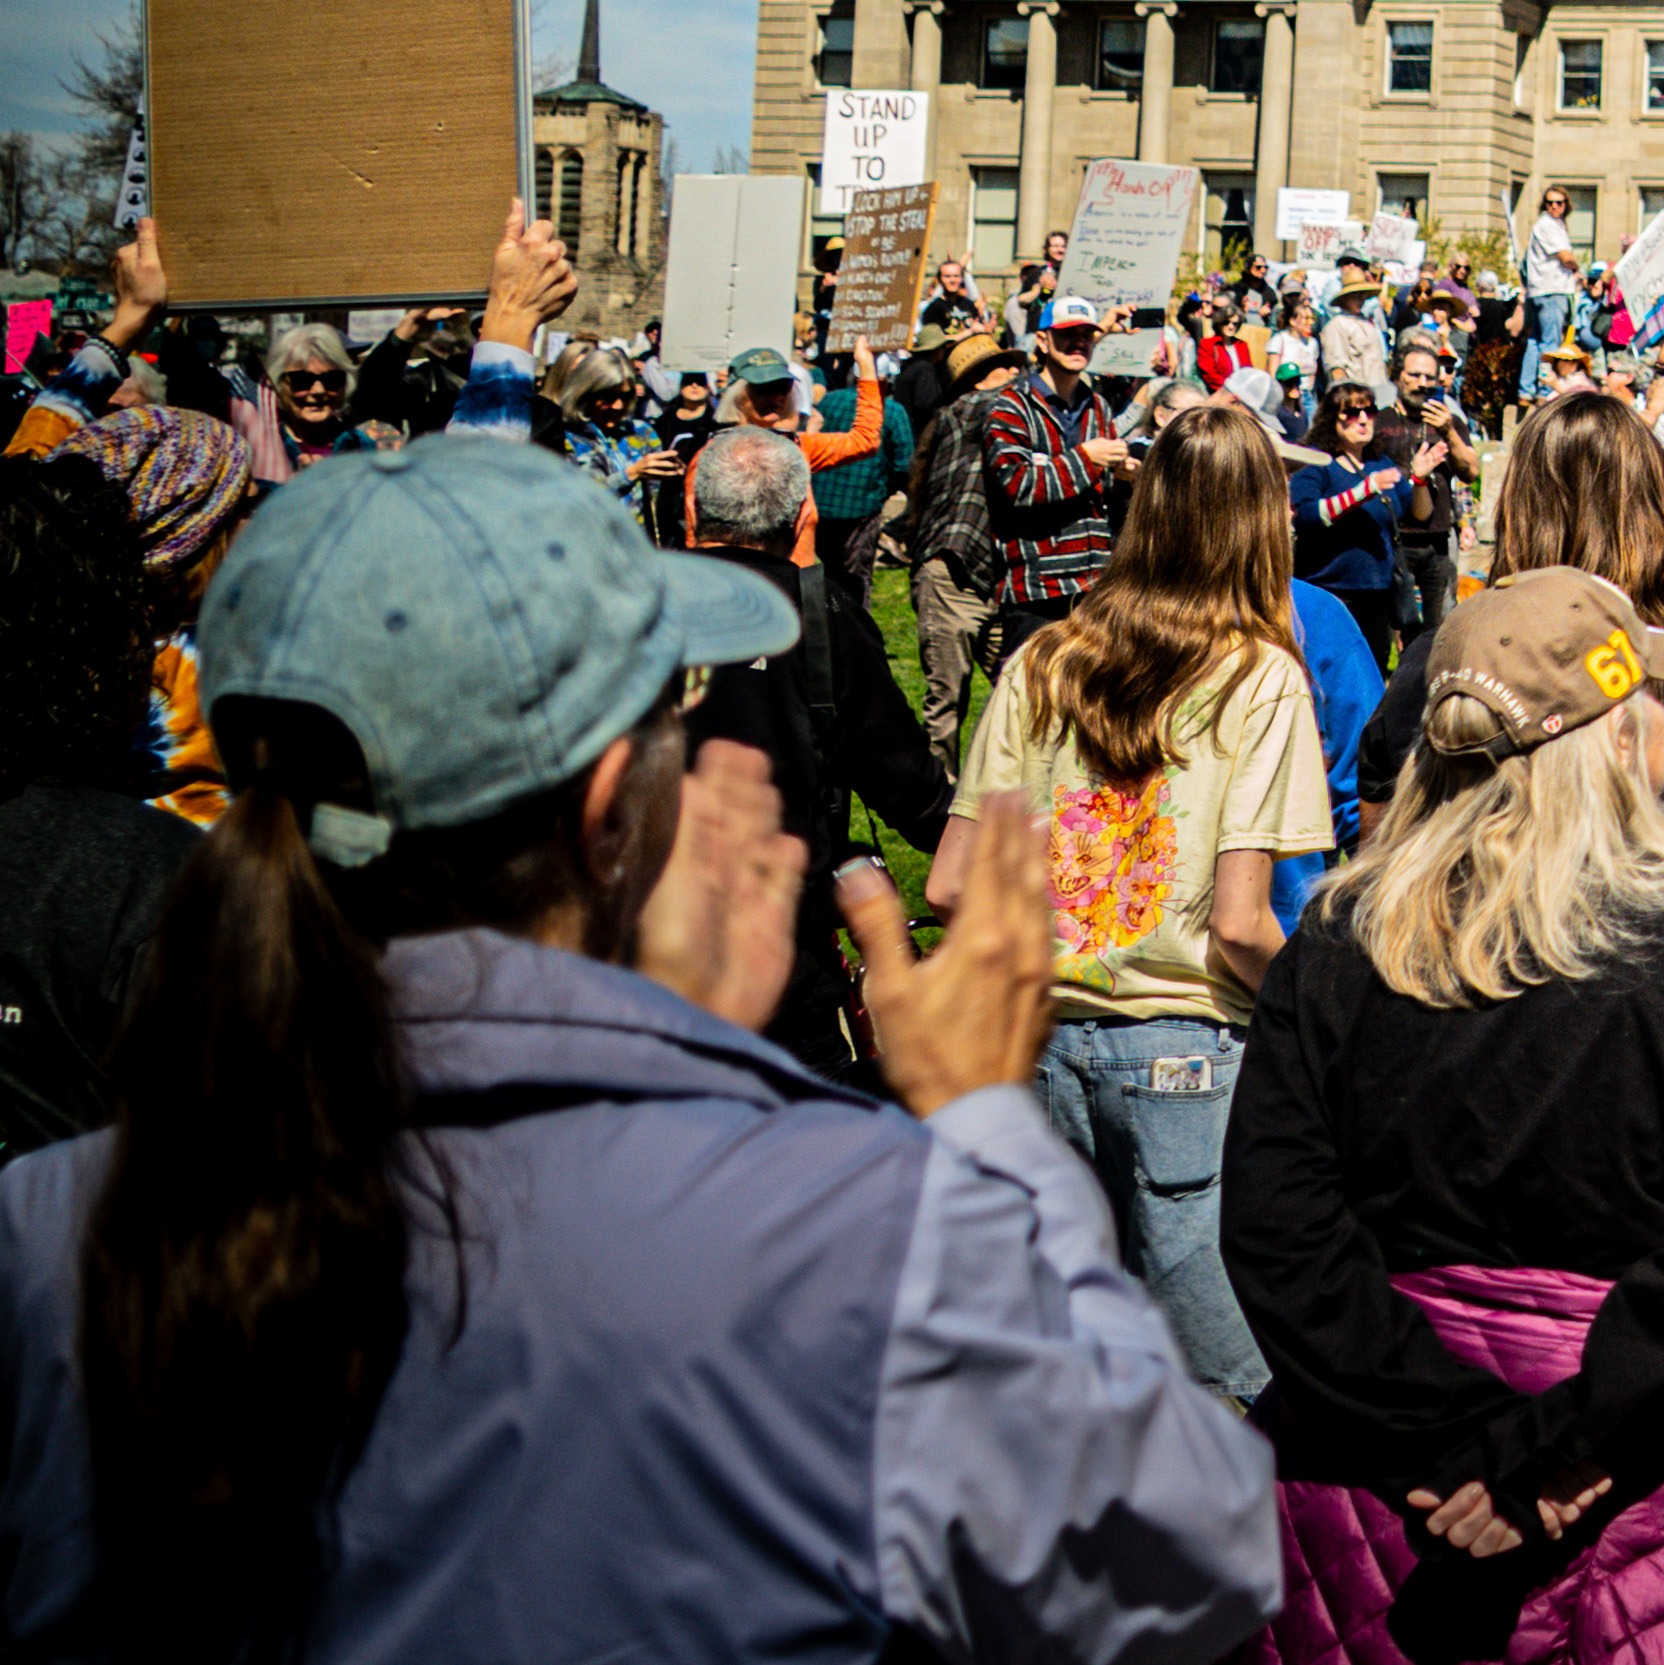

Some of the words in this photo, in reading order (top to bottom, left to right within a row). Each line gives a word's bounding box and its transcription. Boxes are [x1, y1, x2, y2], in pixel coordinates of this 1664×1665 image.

[839, 93, 916, 120] STAND
[854, 124, 887, 148] UP
[852, 155, 885, 180] TO
[1474, 671, 1531, 729] WARHAWK
